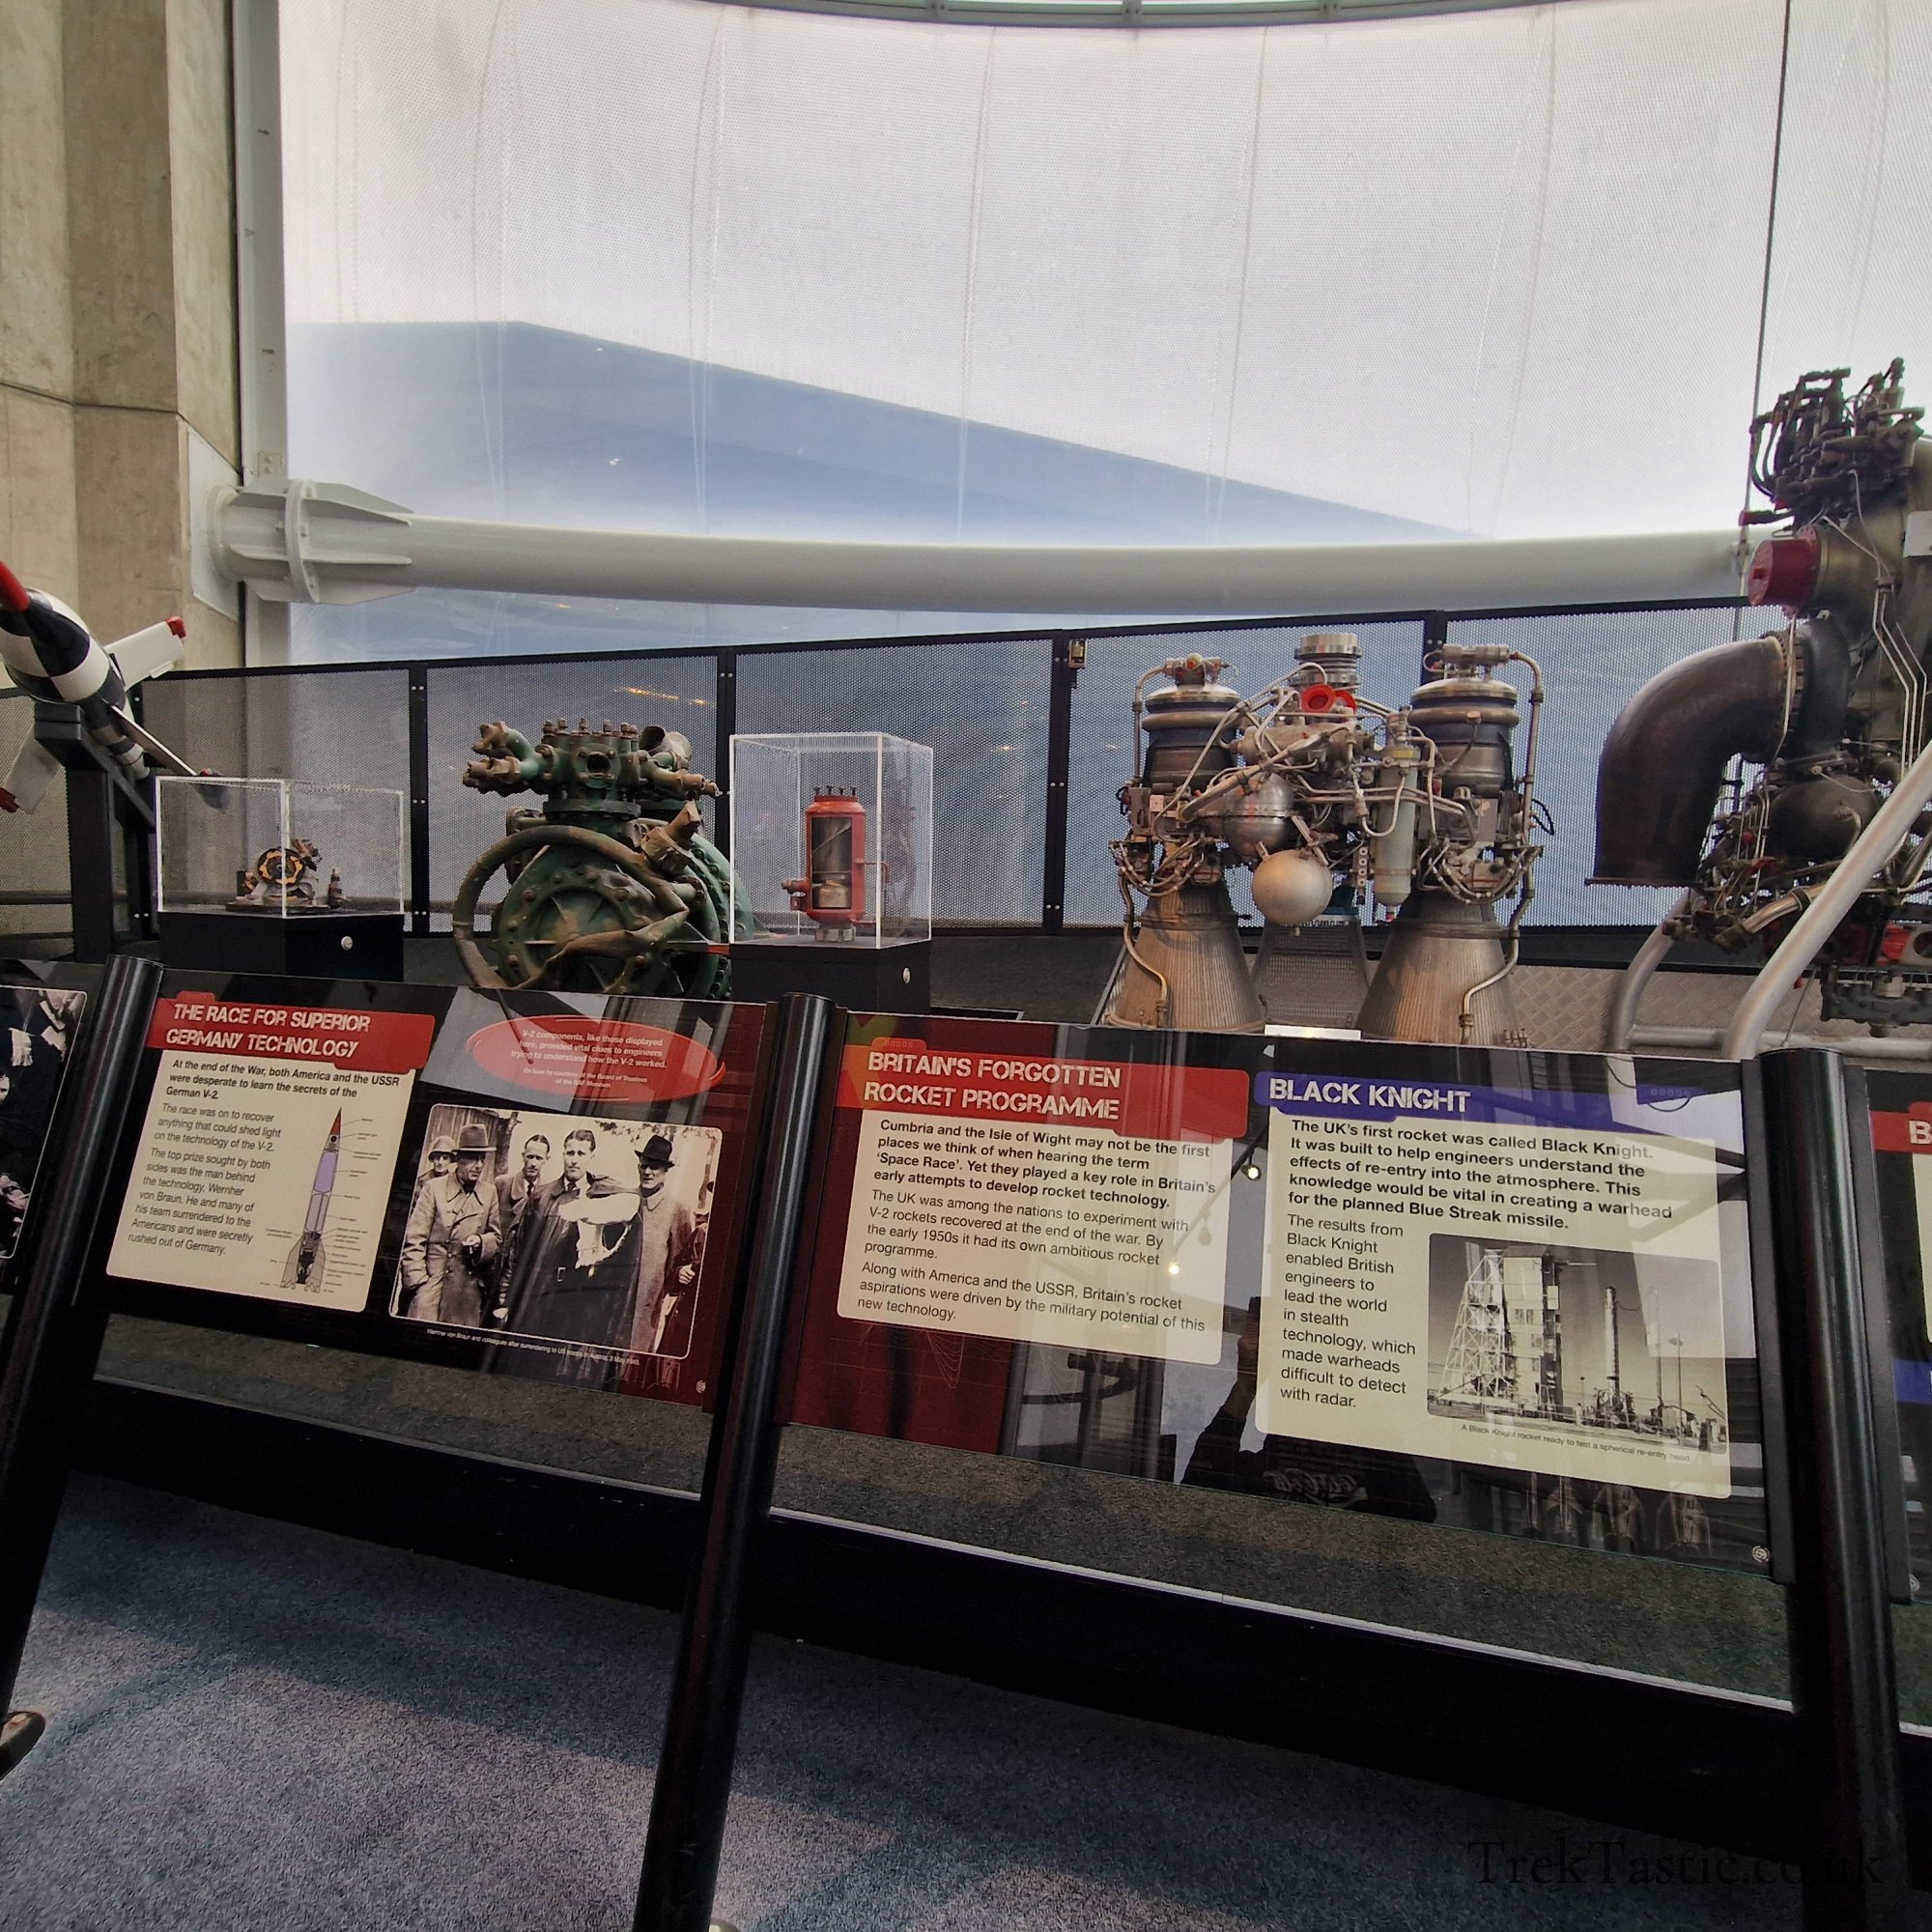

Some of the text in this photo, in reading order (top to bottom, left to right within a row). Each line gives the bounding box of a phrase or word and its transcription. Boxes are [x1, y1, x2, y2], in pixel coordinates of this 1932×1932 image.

[173, 1003, 370, 1031] THE RACE FOR SUPERIOR
[166, 1028, 358, 1057] GERMANY TECHNOLOGY
[172, 1059, 183, 1067] At
[185, 1061, 198, 1069] the
[218, 1063, 229, 1071] of
[230, 1064, 244, 1073] the
[247, 1065, 266, 1076] War,
[269, 1066, 290, 1076] both
[291, 1068, 330, 1080] America
[332, 1073, 351, 1082] and
[353, 1074, 368, 1083] the
[371, 1075, 399, 1086] USSR
[192, 1074, 237, 1087] desperate
[239, 1078, 248, 1088] to
[249, 1079, 273, 1090] learn
[275, 1081, 291, 1091] the
[293, 1085, 327, 1094] secrets
[329, 1086, 340, 1095] of
[342, 1088, 356, 1097] the
[978, 1059, 1121, 1087] FORGOTTEN
[166, 1085, 200, 1096] German
[864, 1081, 1119, 1119] ROCKET PROGRAMME
[1269, 1078, 1470, 1112] BLACK KNIGHT
[162, 1102, 177, 1113] The
[178, 1106, 197, 1115] race
[199, 1108, 215, 1117] was
[231, 1110, 240, 1119] to
[242, 1112, 274, 1122] recover
[880, 1119, 1209, 1156] Cumbria and the Isle of Wight may not be the first
[1292, 1119, 1319, 1132] The
[1362, 1124, 1392, 1138] first
[1397, 1129, 1447, 1142] rocket
[1452, 1134, 1483, 1145] was
[1489, 1136, 1536, 1149] called
[1542, 1138, 1587, 1152] Black
[1593, 1142, 1652, 1158] Knight.
[151, 1147, 270, 1169] The top prize sought by both
[1291, 1137, 1644, 1177] It was built to help engineers understand the
[967, 1159, 987, 1172] Yet
[990, 1162, 1019, 1177] they
[1022, 1165, 1066, 1179] played
[1070, 1172, 1078, 1180] a
[1083, 1170, 1107, 1185] key
[1111, 1174, 1137, 1185] role
[1141, 1179, 1152, 1187] in
[873, 1170, 1169, 1208] early attempts to develop rocket technology.
[872, 1188, 1187, 1231] The UK was among the nations to experiment with
[1288, 1191, 1568, 1228] for the planned Blue Streak missile.
[1288, 1213, 1403, 1236] The results from
[128, 1234, 226, 1256] rushed out of Germany.
[864, 1242, 936, 1258] programme.
[1287, 1232, 1377, 1254] Black Knight
[857, 1298, 955, 1321] new technology.
[1282, 1327, 1415, 1354] technology, which
[1280, 1386, 1355, 1406] with radar.
